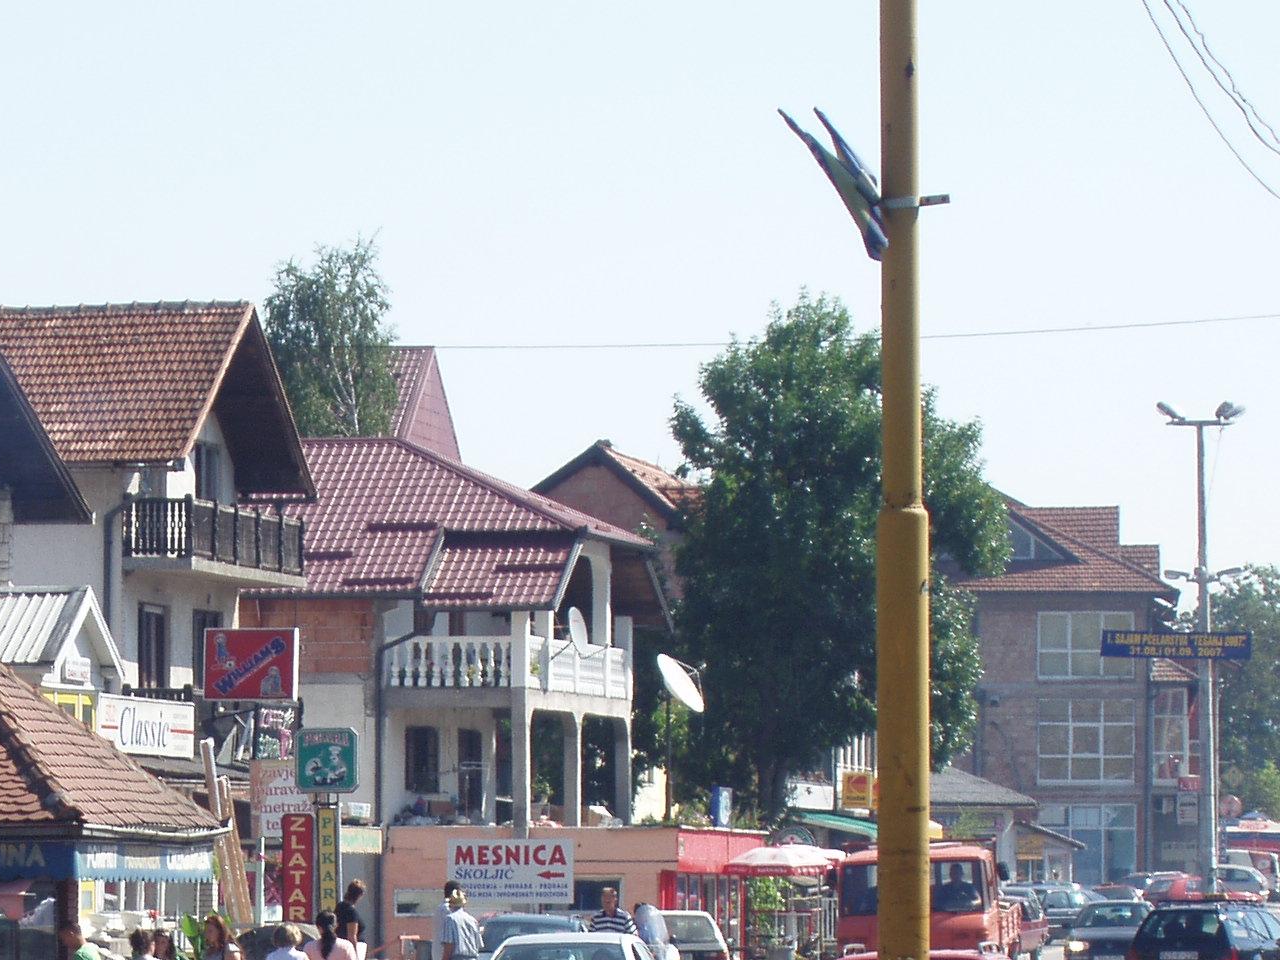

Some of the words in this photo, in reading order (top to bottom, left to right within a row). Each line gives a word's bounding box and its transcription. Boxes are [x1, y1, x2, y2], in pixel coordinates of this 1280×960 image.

[119, 707, 170, 748] Classic
[288, 816, 309, 921] ZLATAR
[321, 816, 335, 911] PEKAR
[454, 844, 567, 866] MESNICA
